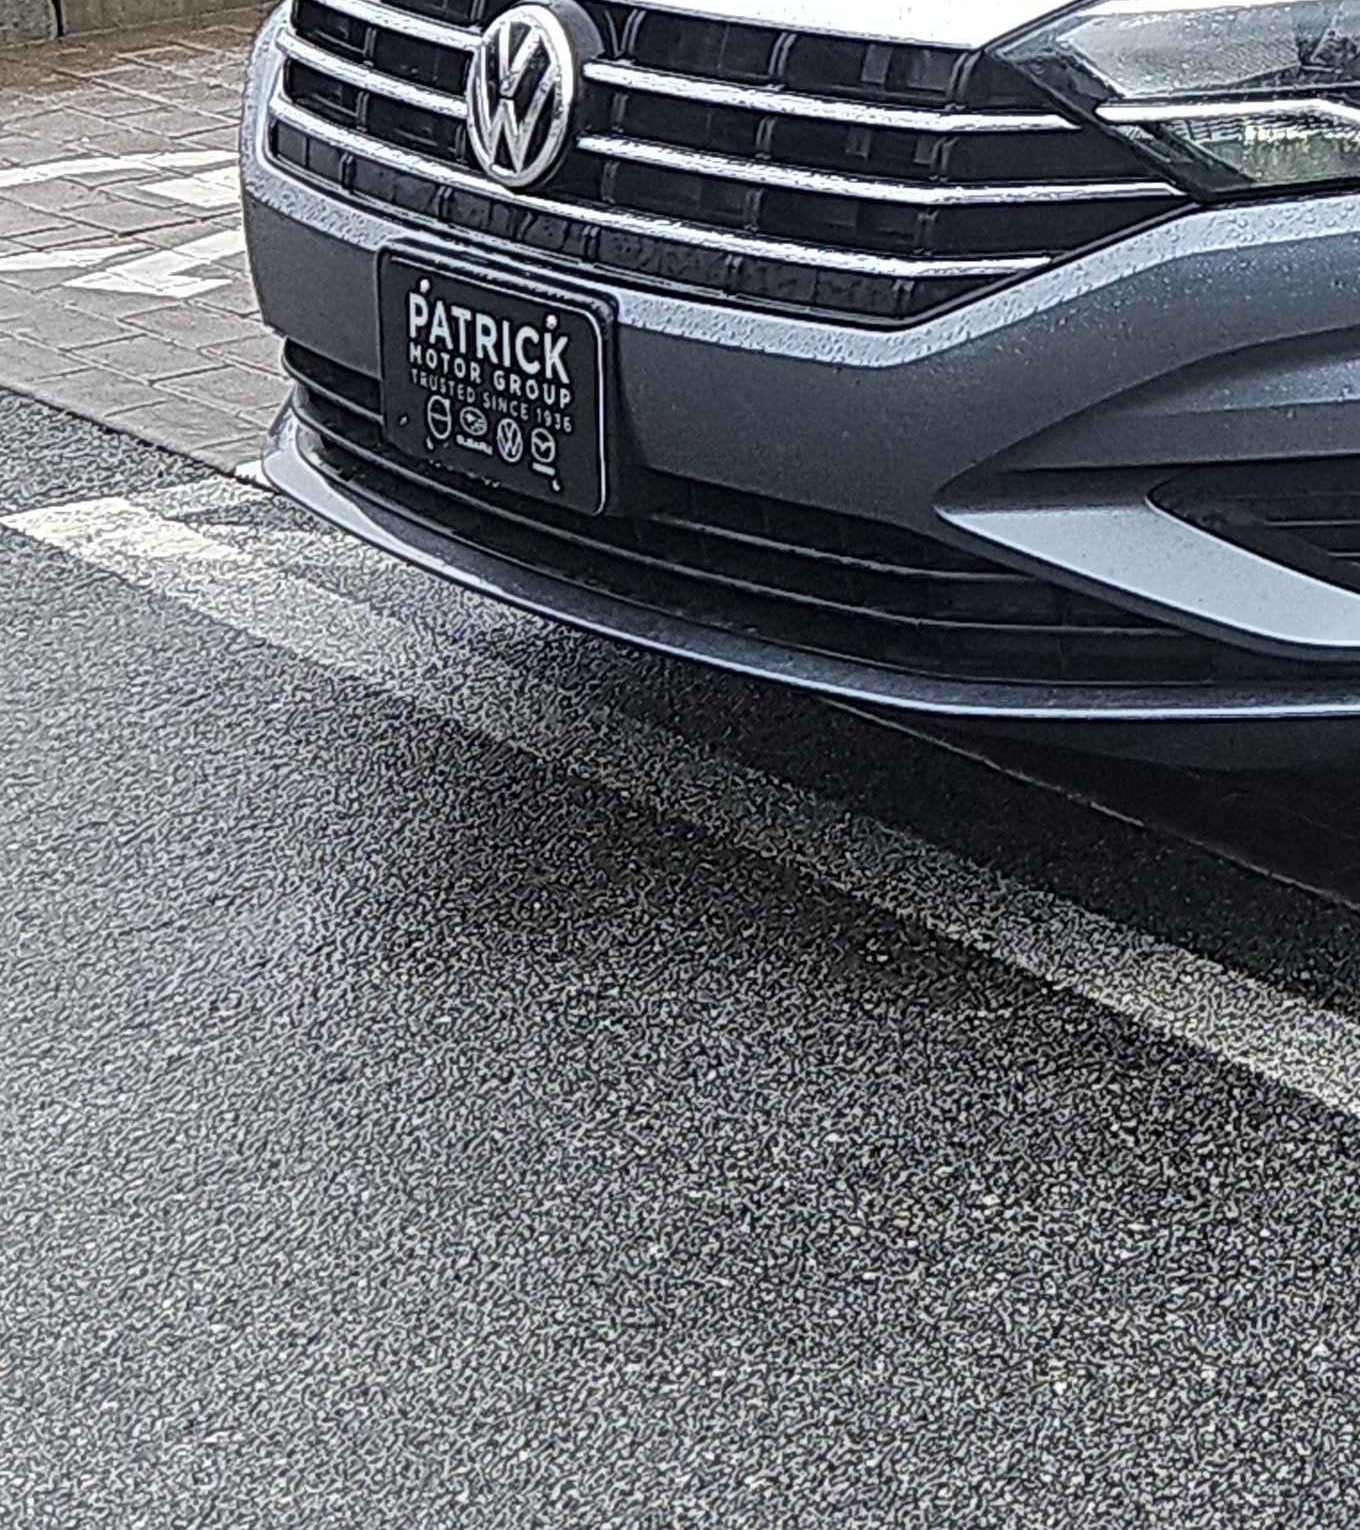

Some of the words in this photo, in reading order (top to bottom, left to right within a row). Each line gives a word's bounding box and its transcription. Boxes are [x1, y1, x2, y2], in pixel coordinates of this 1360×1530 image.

[409, 291, 570, 384] PATRICK
[409, 342, 482, 384] MOTOR
[493, 370, 572, 409] GROUP
[411, 368, 476, 403] TRUSTED
[482, 392, 529, 421] SINCE
